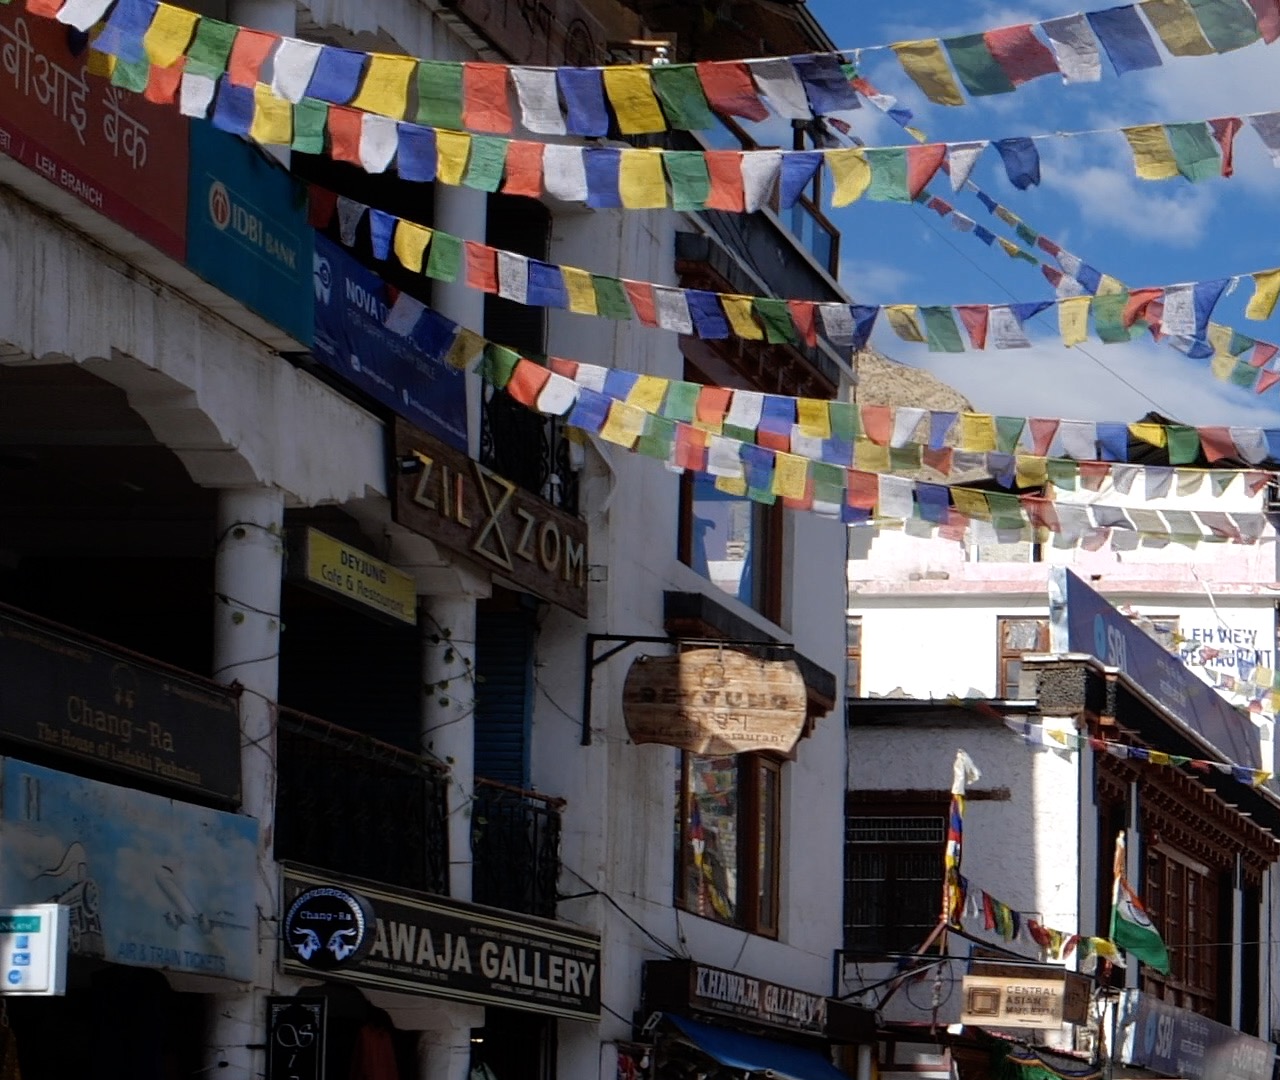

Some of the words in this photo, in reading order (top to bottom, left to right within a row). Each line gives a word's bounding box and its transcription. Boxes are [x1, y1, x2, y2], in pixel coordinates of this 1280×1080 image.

[35, 152, 56, 178] LEH
[60, 163, 103, 208] BRANCH
[231, 201, 263, 247] IDBI
[265, 234, 298, 270] BANK
[345, 277, 379, 320] NOVA
[340, 549, 387, 585] DEYJUNG
[1107, 624, 1127, 674] SBI
[67, 695, 175, 752] Chang-Ra
[299, 909, 352, 922] Chang-Ra
[118, 942, 138, 960] AIR
[150, 945, 181, 963] TRAIN
[183, 950, 227, 972] TICKETS
[370, 917, 473, 976] AWAJA
[480, 940, 597, 998] GALLERY
[695, 965, 761, 1009] KHAWAJA
[1006, 985, 1057, 996] CENTRAL
[1156, 1013, 1175, 1060] SBI
